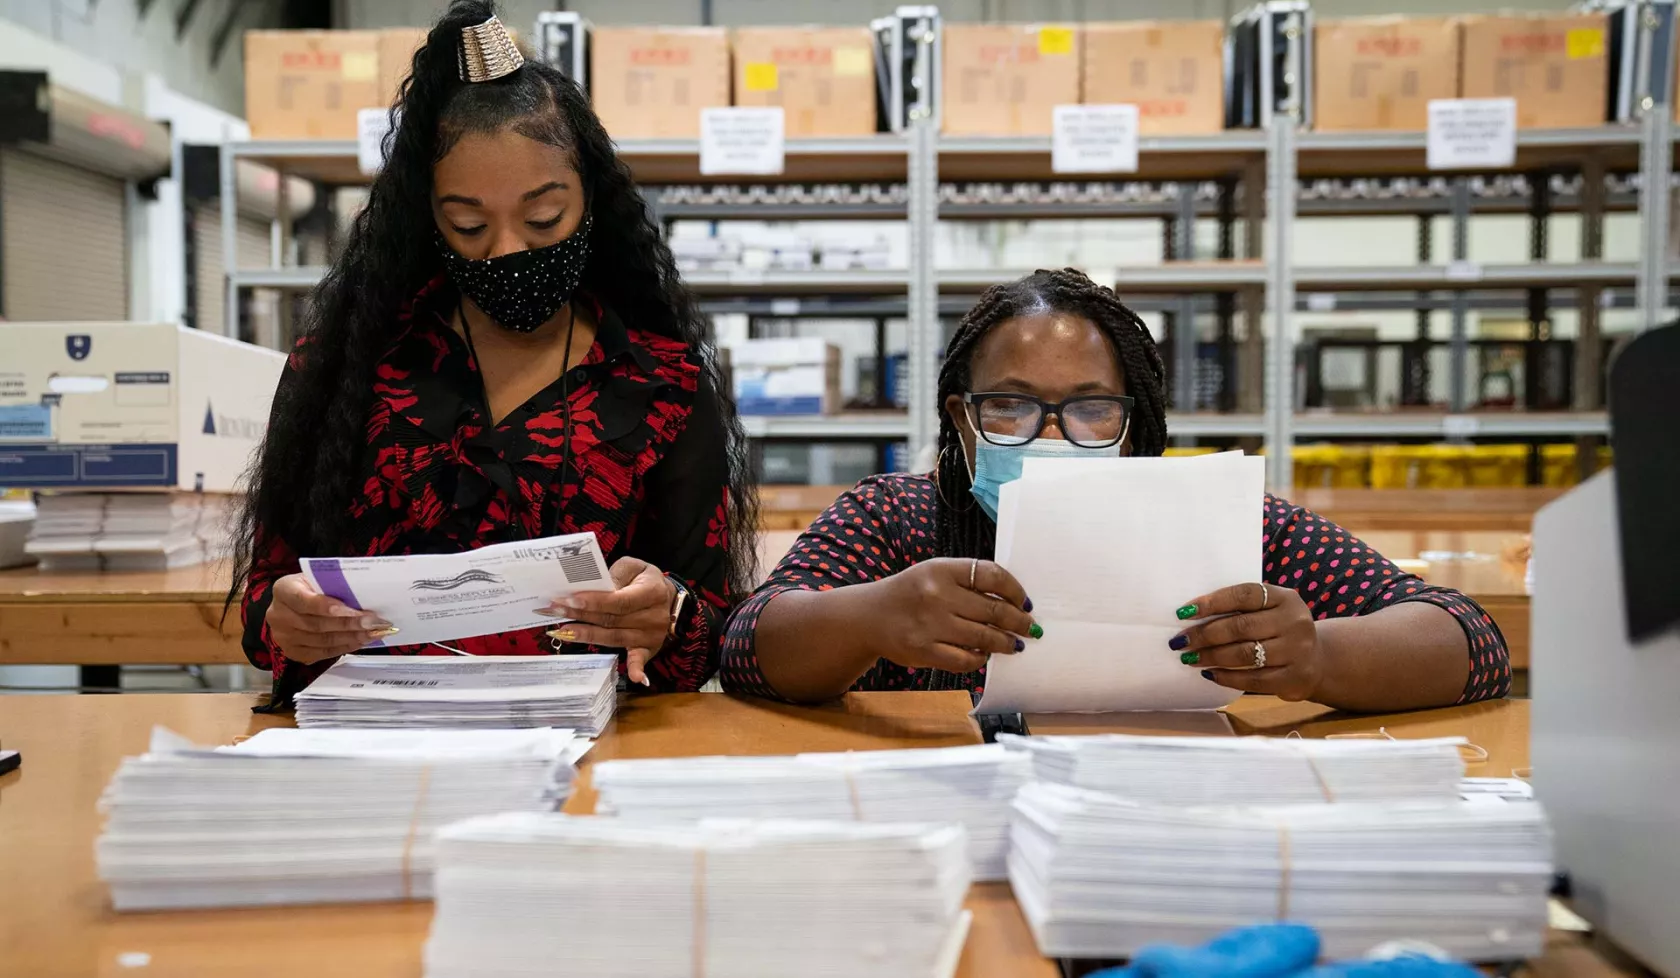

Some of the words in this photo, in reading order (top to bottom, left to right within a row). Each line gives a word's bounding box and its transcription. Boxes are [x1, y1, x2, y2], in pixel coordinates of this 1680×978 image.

[418, 593, 459, 603] BUSINESS
[461, 590, 488, 599] REPLY
[489, 587, 507, 595] MAIL
